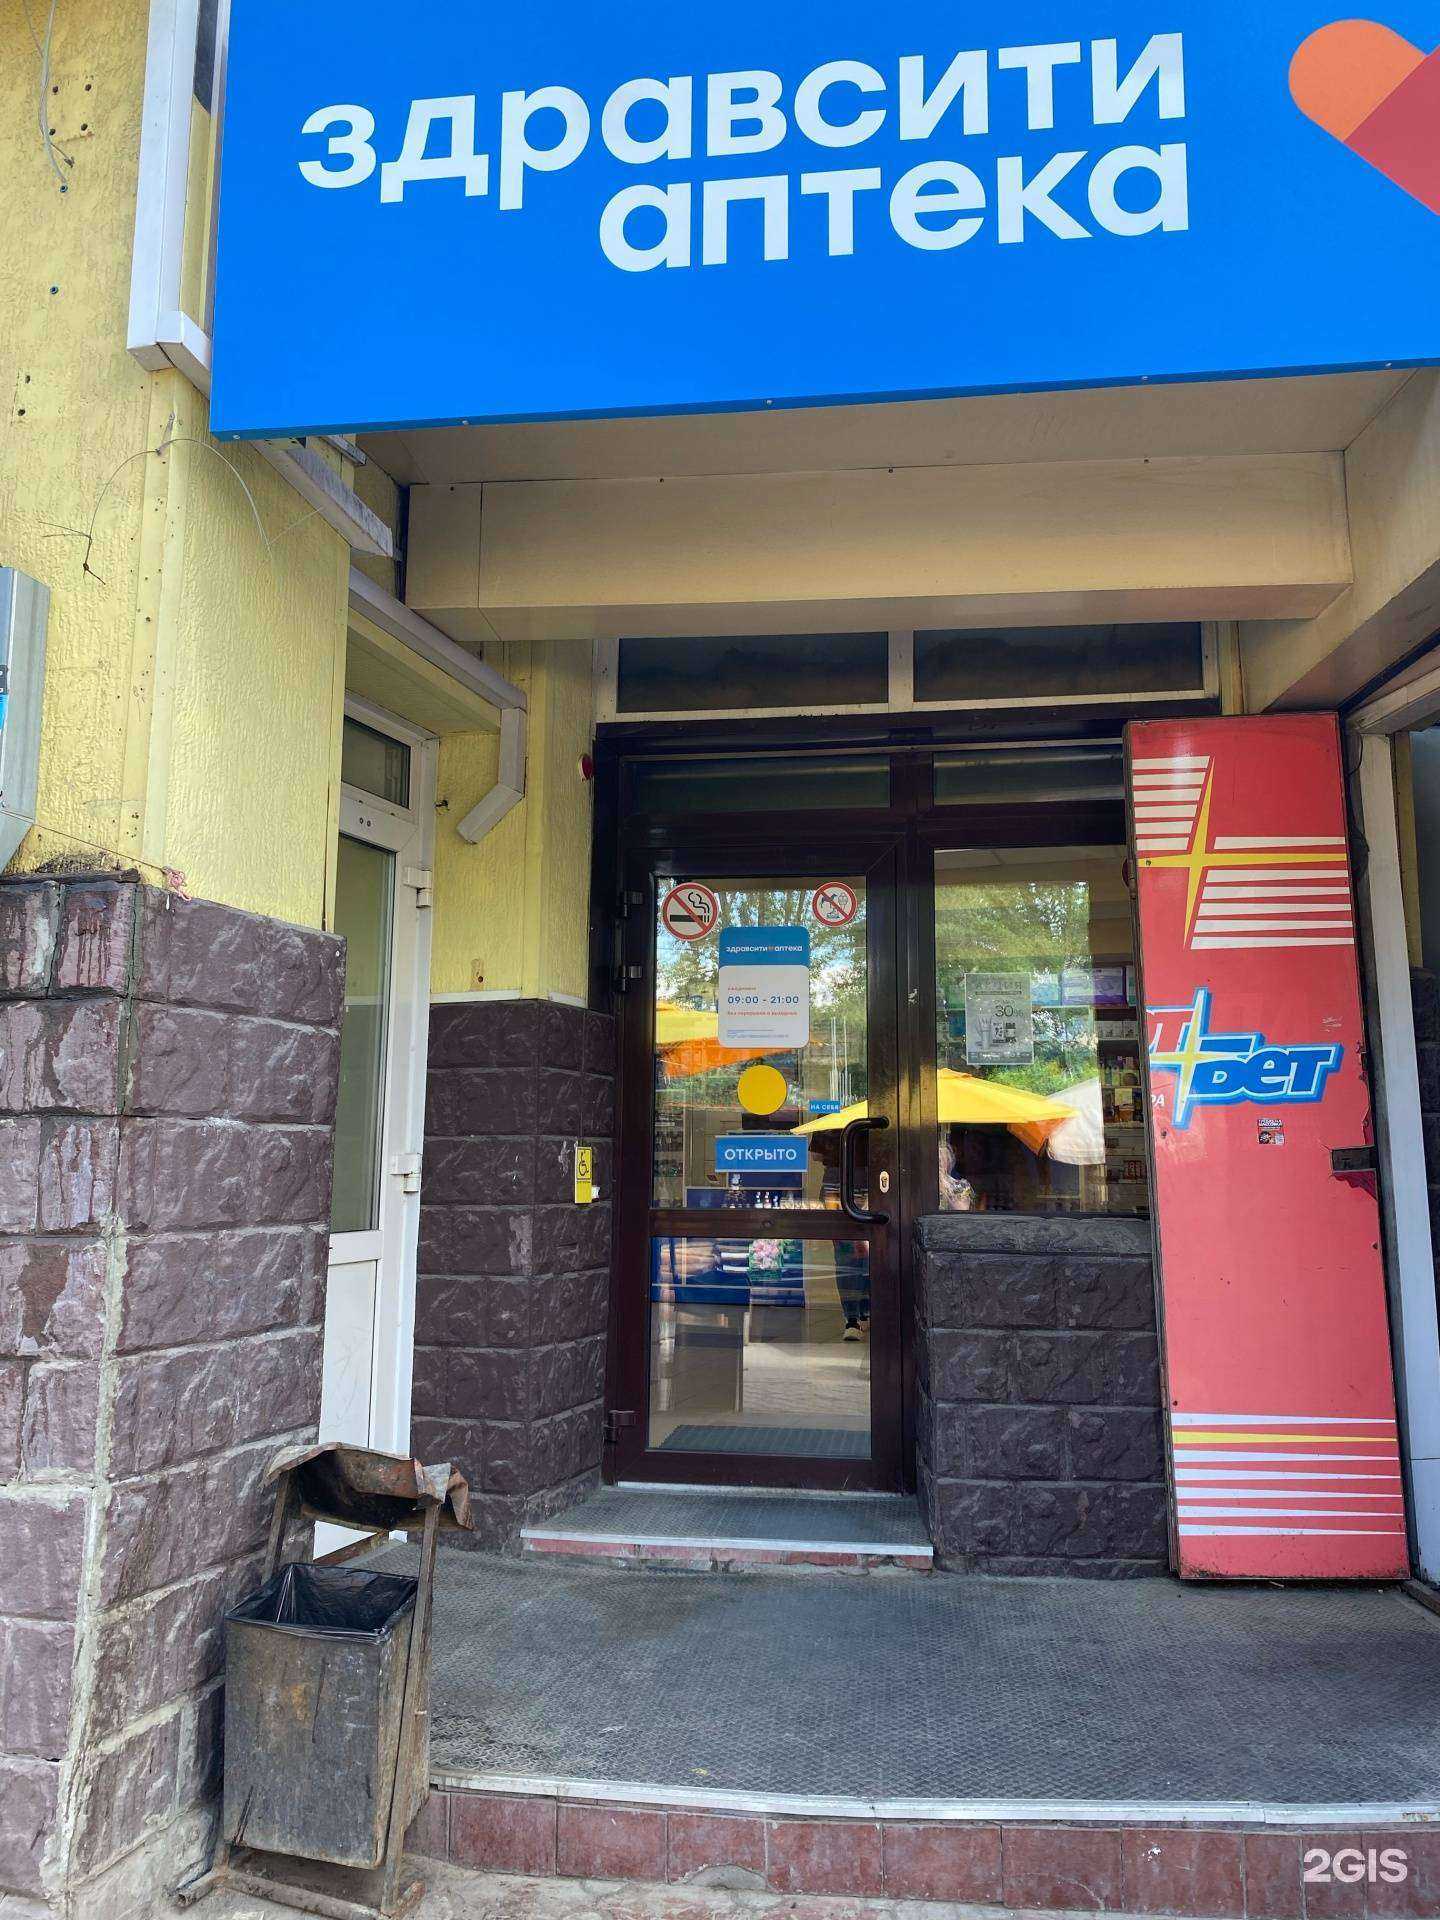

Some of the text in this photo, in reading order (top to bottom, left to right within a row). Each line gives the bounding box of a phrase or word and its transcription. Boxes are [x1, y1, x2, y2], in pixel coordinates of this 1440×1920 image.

[298, 32, 1187, 211] здравсити
[600, 142, 1190, 273] аптека
[725, 945, 768, 954] здравсити
[727, 996, 759, 1004] 09:00
[770, 996, 799, 1004] 21:00
[724, 1147, 797, 1162] ОТКРЫТО
